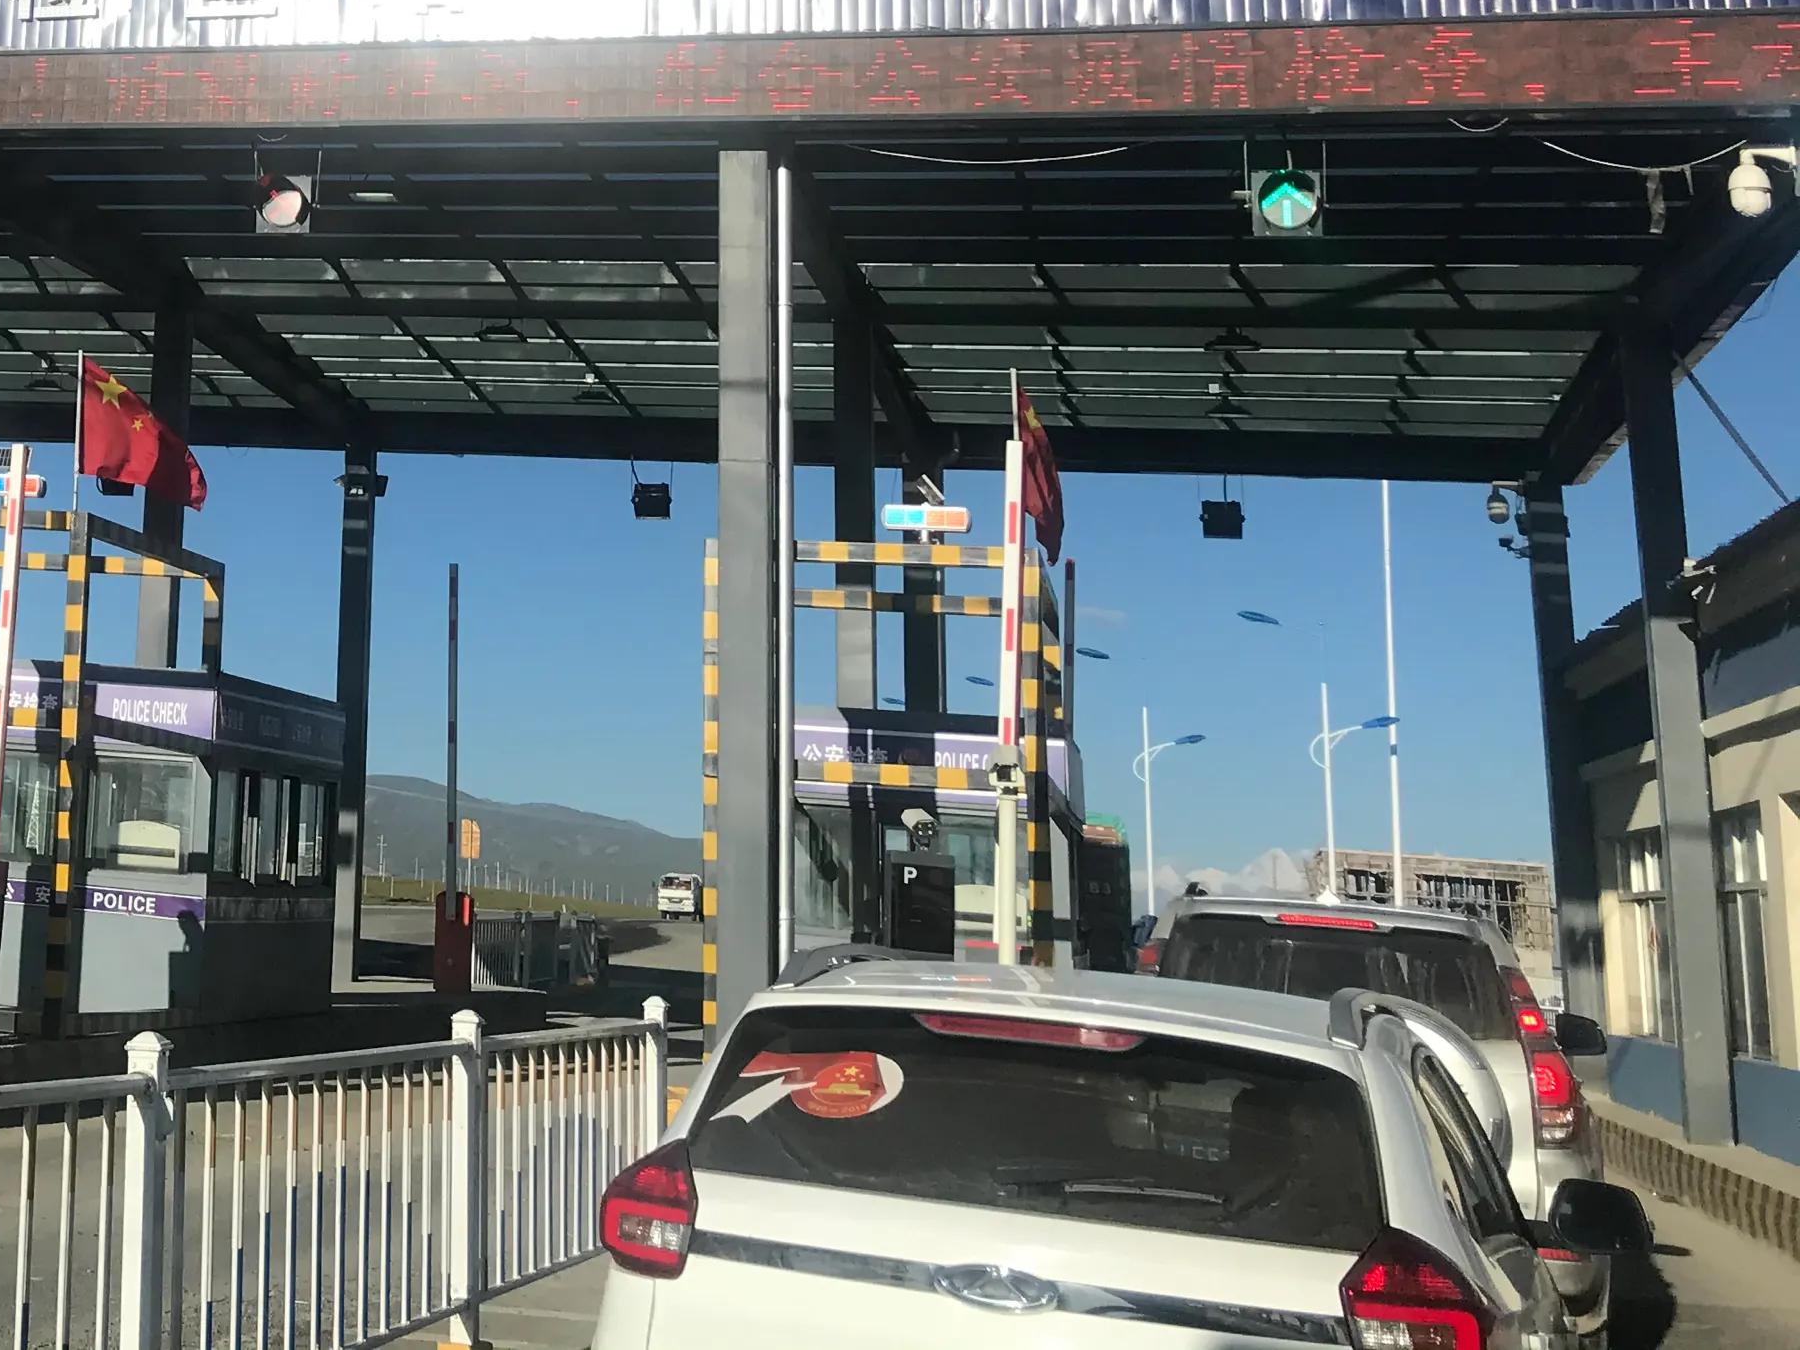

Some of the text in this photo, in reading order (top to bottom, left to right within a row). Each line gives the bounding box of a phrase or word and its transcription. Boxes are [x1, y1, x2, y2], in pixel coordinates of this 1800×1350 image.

[8, 691, 188, 725] 安检查 POLICE CHECK
[903, 867, 918, 885] P
[92, 892, 157, 914] POLICE
